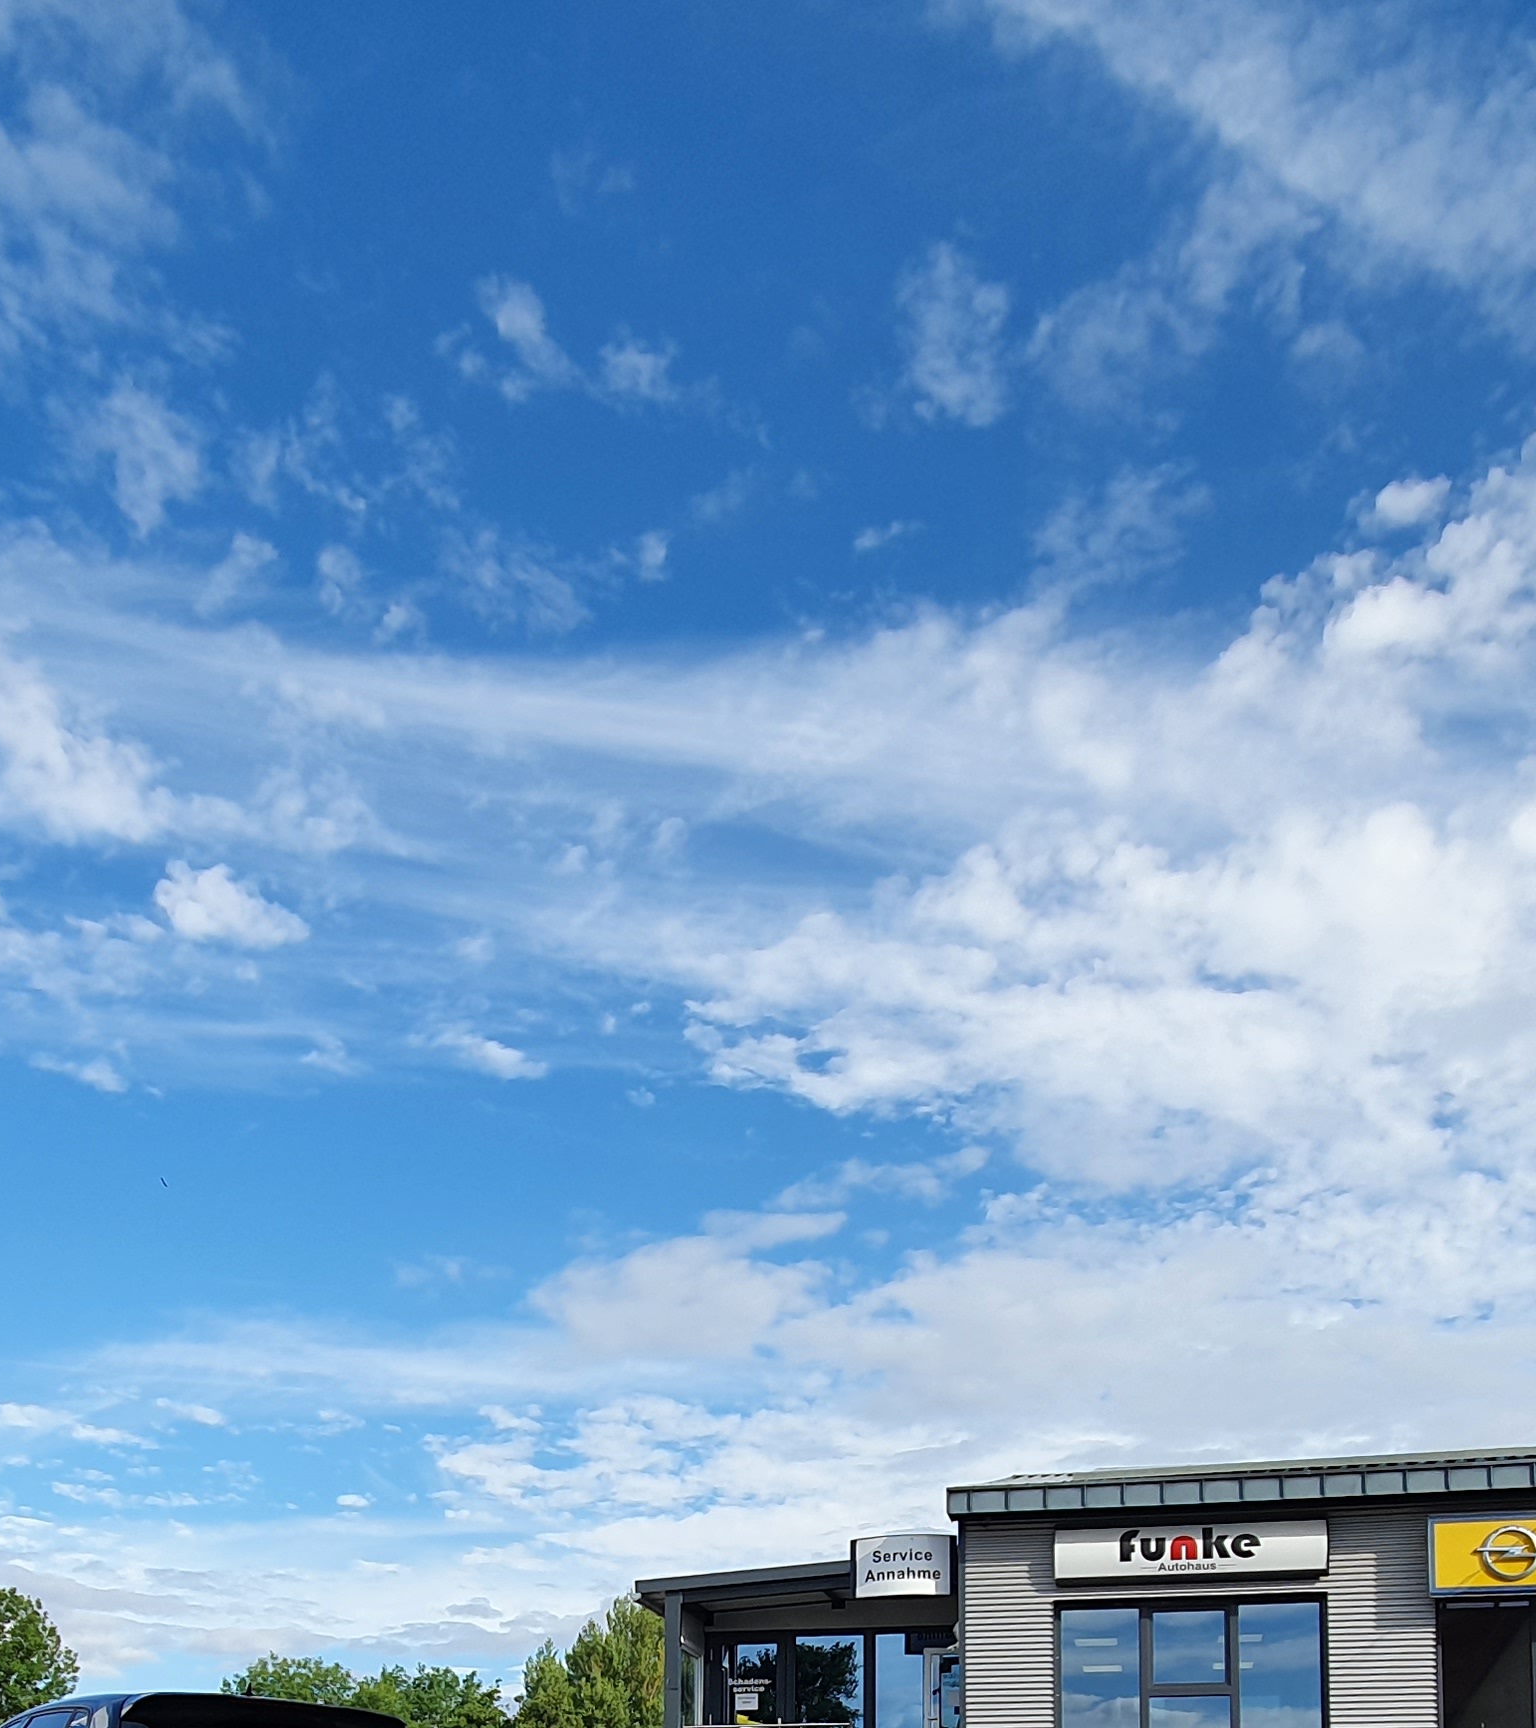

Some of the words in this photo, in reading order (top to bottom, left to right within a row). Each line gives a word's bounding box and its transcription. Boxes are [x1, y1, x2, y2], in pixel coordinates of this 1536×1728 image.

[1119, 1527, 1261, 1562] funke
[872, 1548, 933, 1563] Service
[1158, 1562, 1217, 1572] Autohaus
[865, 1567, 941, 1583] Annahme
